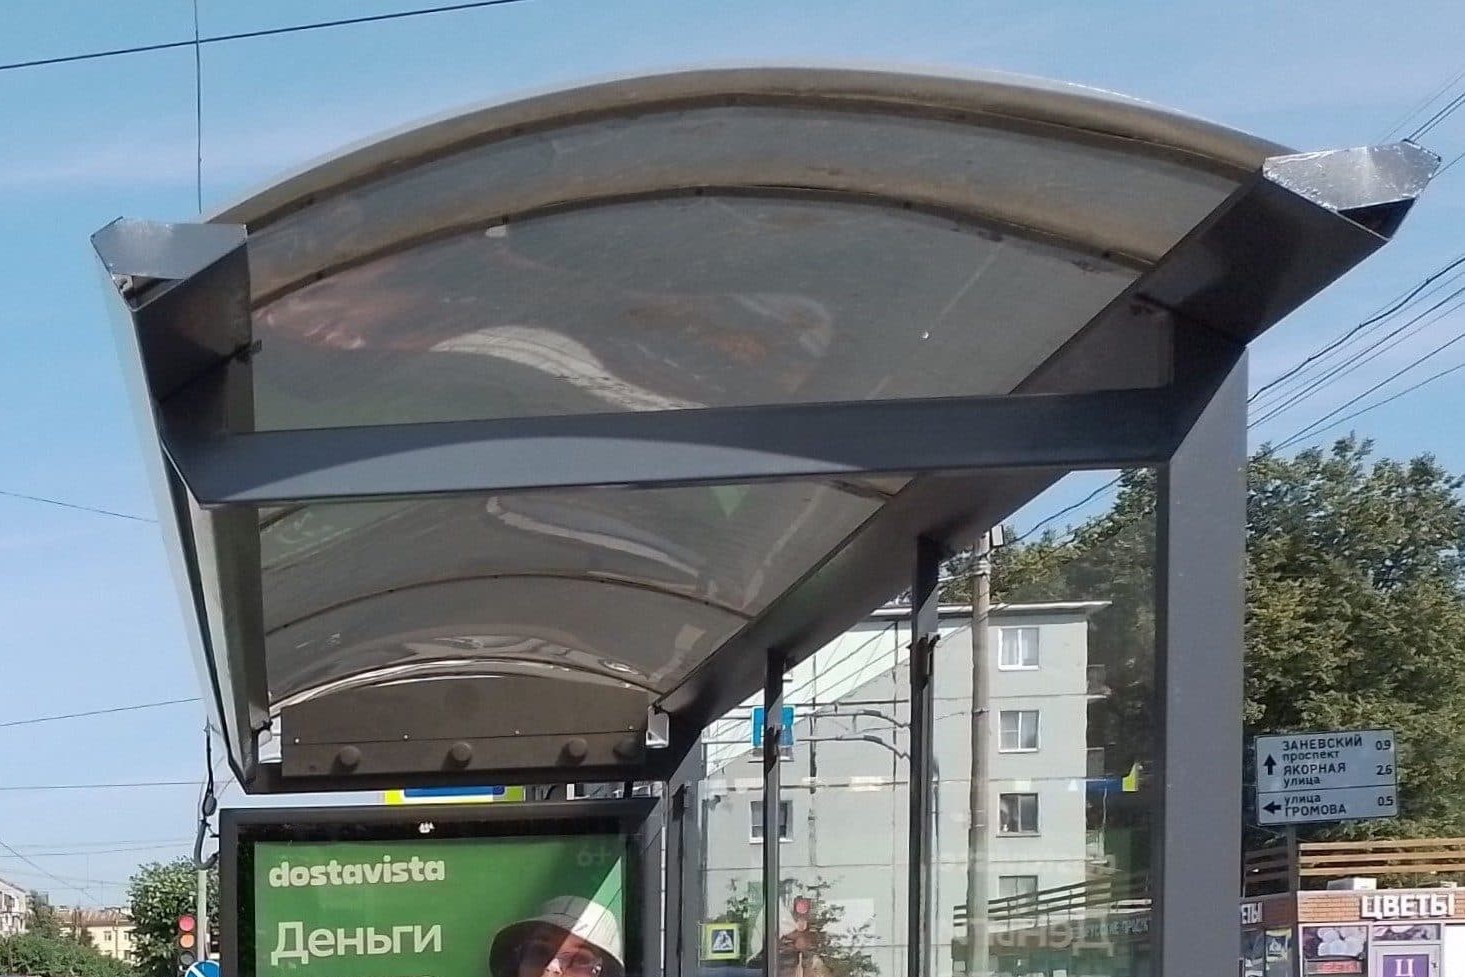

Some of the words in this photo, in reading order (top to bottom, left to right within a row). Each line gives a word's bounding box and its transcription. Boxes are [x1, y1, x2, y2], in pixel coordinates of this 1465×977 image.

[1282, 734, 1363, 751] ЗАНЕВСКИЙ
[1282, 750, 1340, 763] проспект
[1283, 762, 1347, 776] ЯКОРНАЯ
[1283, 777, 1321, 789] улица
[1284, 795, 1322, 807] улица
[1285, 804, 1347, 817] ГРОМОВА
[269, 855, 446, 888] dostavista
[1362, 893, 1455, 920] ЦВЕТЫ
[270, 921, 443, 967] Деньги
